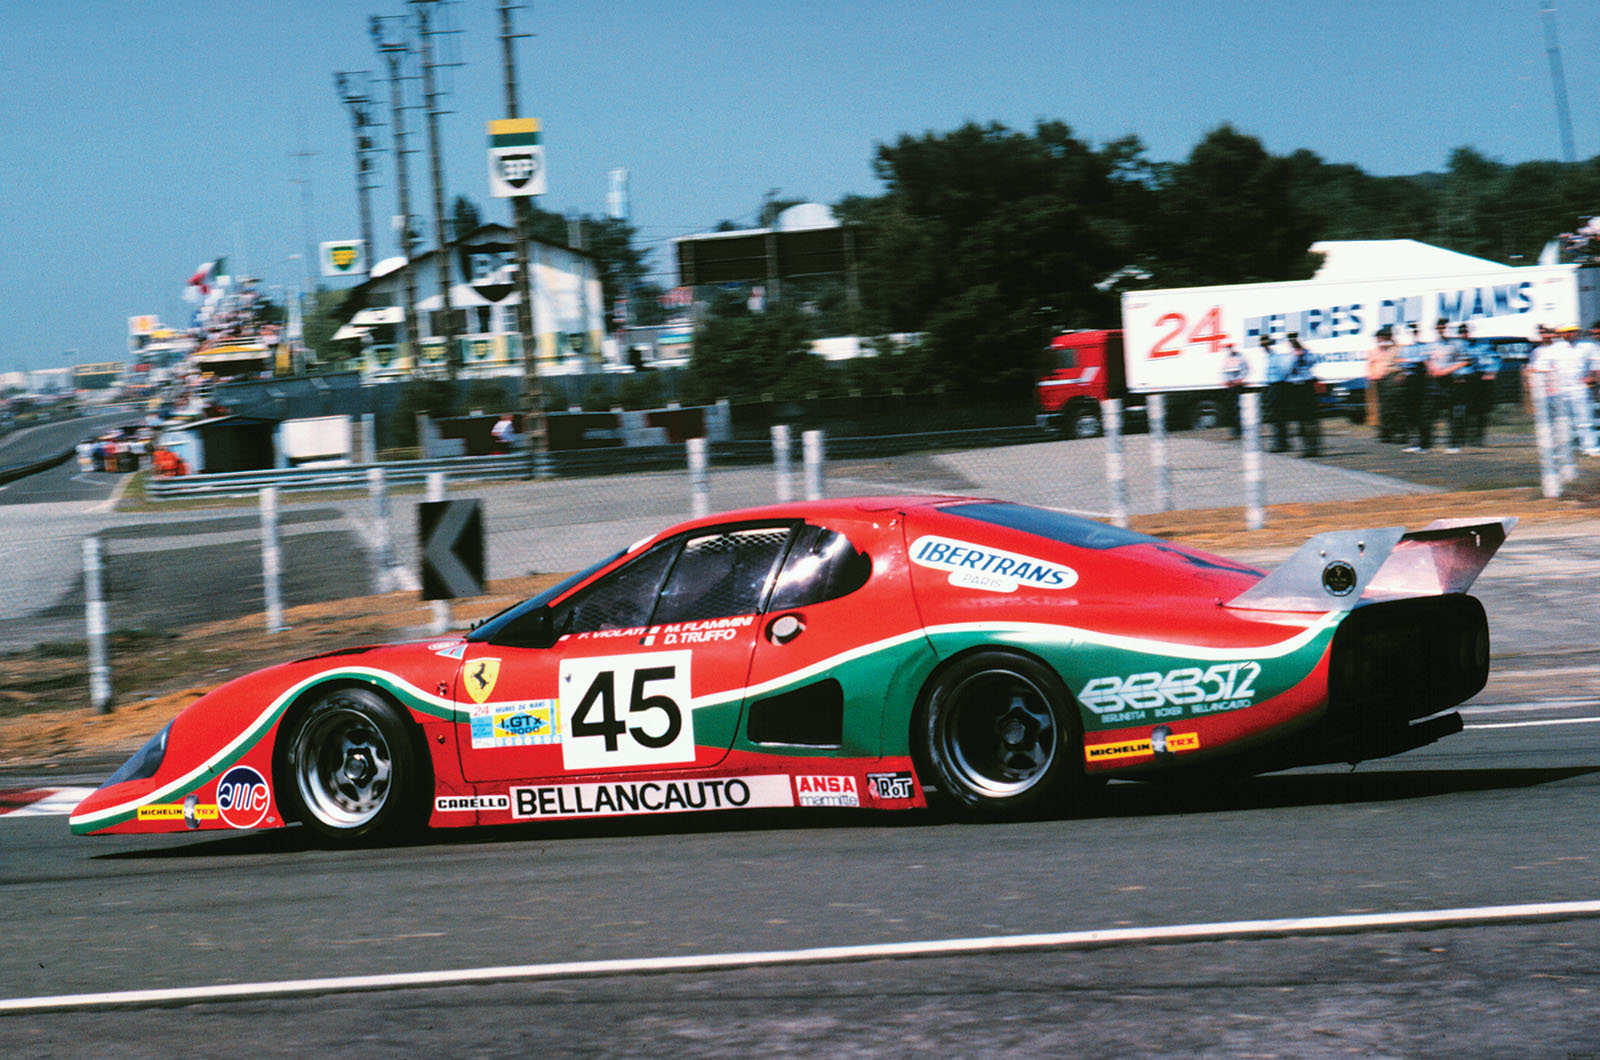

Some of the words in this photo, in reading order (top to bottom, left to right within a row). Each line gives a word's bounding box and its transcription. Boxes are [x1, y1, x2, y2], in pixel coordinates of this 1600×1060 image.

[1147, 308, 1229, 358] 24
[915, 541, 1069, 585] IBERTRANS
[962, 573, 1001, 587] PARIS
[664, 624, 681, 634] M.
[682, 616, 754, 632] FLAMMINI
[664, 633, 678, 645] D.
[681, 628, 737, 644] TRUFFO
[473, 705, 489, 717] 24
[571, 665, 682, 752] 45
[1090, 743, 1150, 757] MICHELIN
[1169, 737, 1195, 748] TRX
[799, 777, 856, 793] ANSA
[437, 797, 508, 809] CARELLO
[516, 778, 750, 816] BELLANCAUTO
[196, 808, 216, 816] TRX
